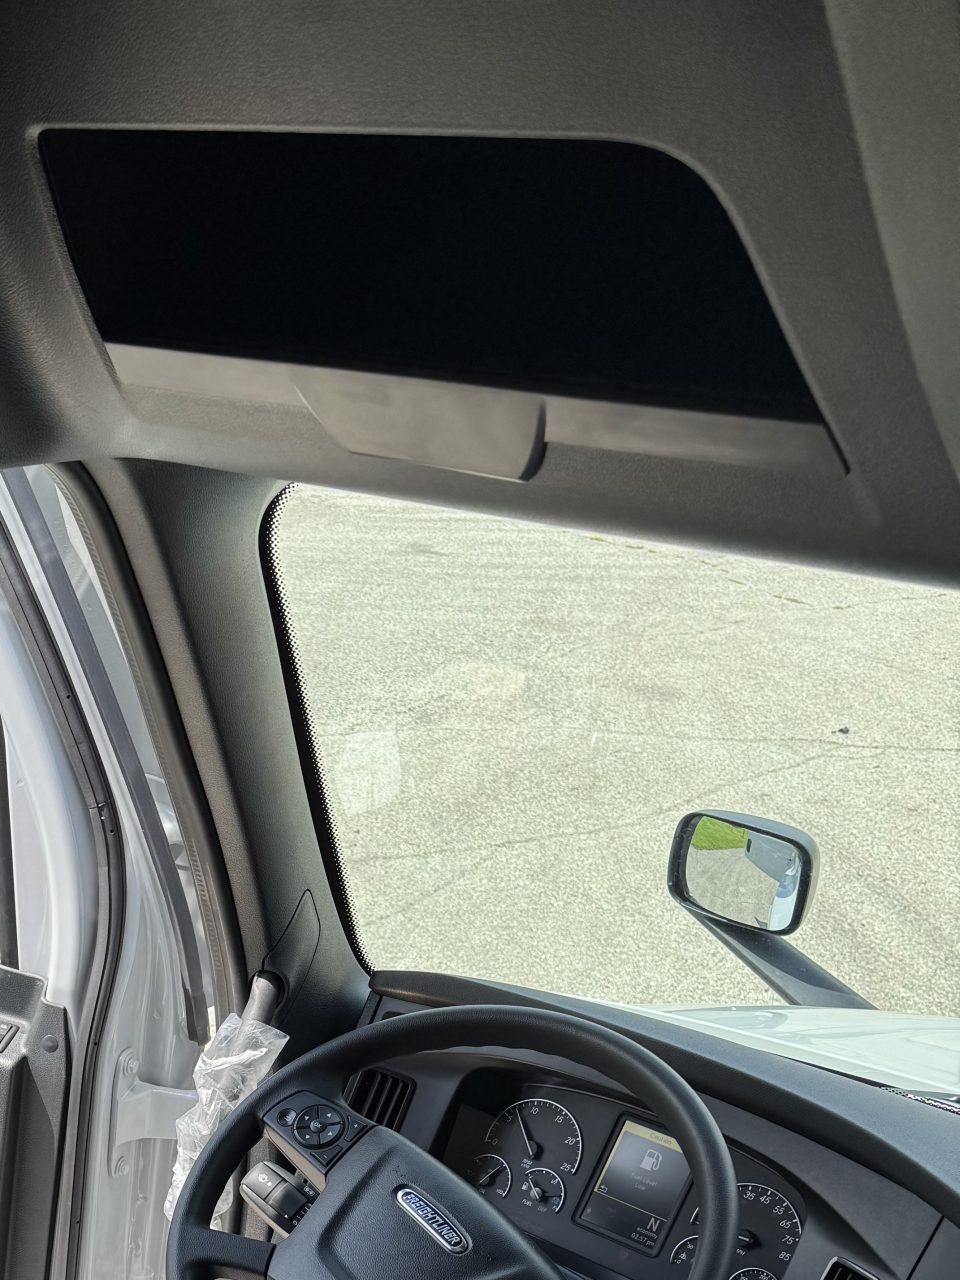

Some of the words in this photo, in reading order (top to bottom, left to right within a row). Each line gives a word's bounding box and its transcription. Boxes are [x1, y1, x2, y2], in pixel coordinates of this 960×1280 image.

[555, 1115, 564, 1123] 15
[564, 1137, 576, 1145] 20
[560, 1163, 571, 1171] 25
[743, 1191, 756, 1201] 35
[759, 1195, 771, 1205] 45
[522, 1199, 533, 1207] FUEL
[773, 1205, 784, 1215] 55
[403, 1193, 461, 1245] FREIGHTLINER
[646, 1217, 660, 1233] N
[780, 1220, 791, 1229] 65
[637, 1227, 658, 1239] economy
[782, 1235, 793, 1245] 75
[779, 1251, 791, 1261] 85
